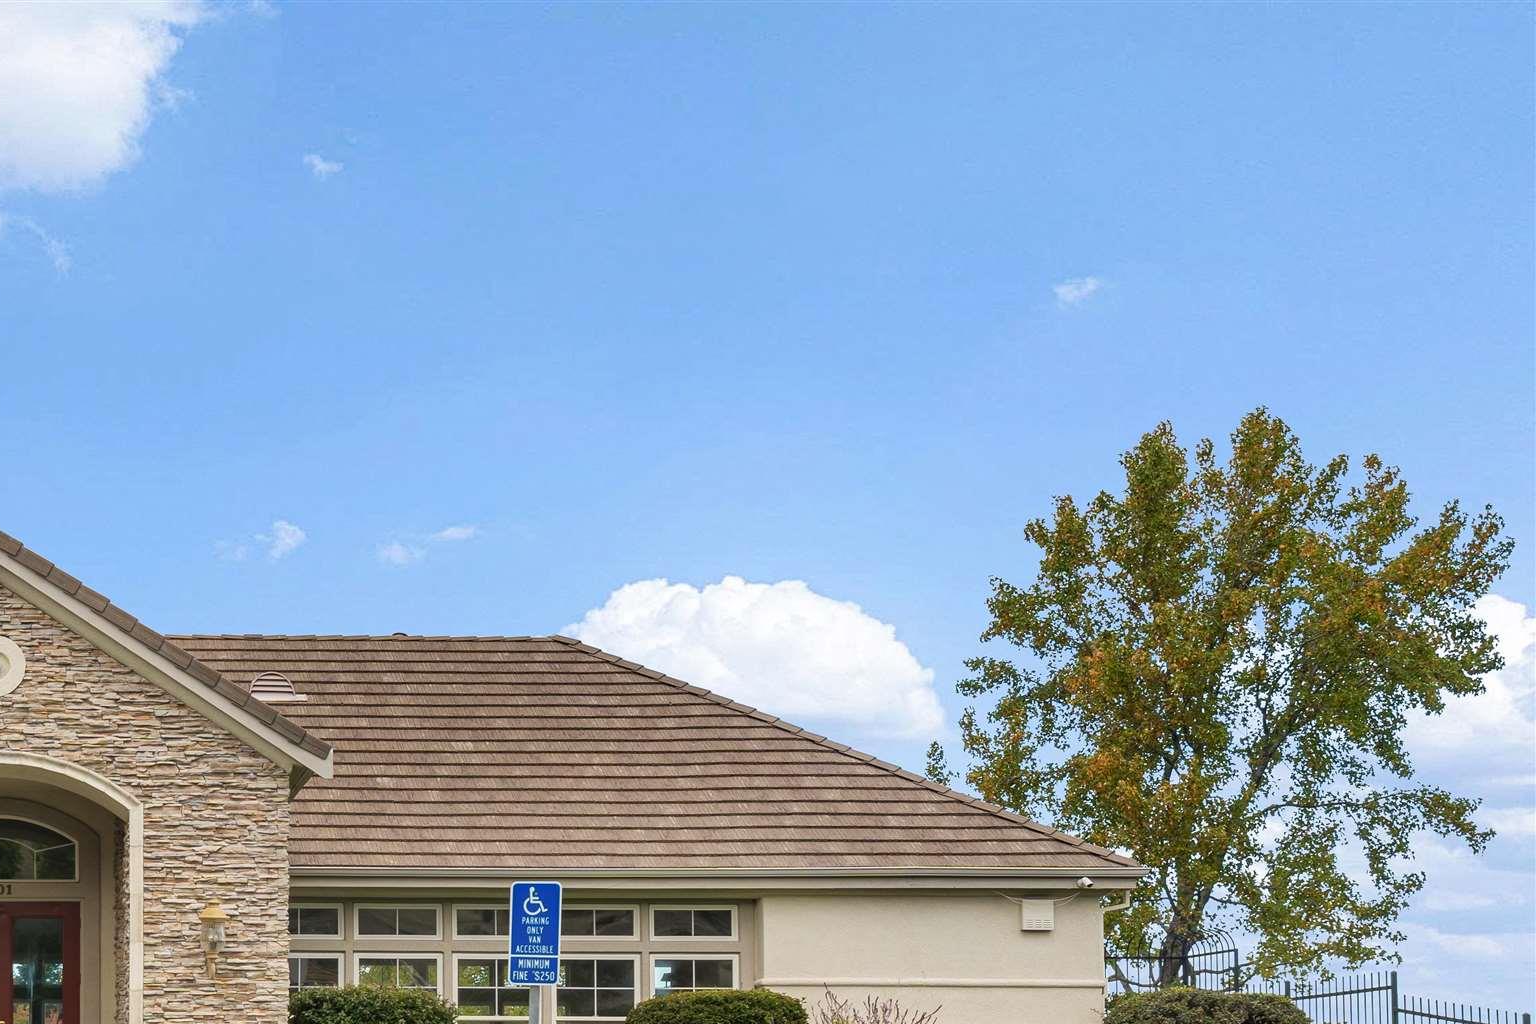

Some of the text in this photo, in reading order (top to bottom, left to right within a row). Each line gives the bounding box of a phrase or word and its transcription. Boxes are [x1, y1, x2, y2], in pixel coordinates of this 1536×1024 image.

[522, 916, 550, 925] PARKING
[526, 926, 544, 934] ONLY
[516, 944, 554, 953] ACCESSIBLE
[518, 959, 550, 968] MINIMUM
[512, 970, 529, 981] FINE
